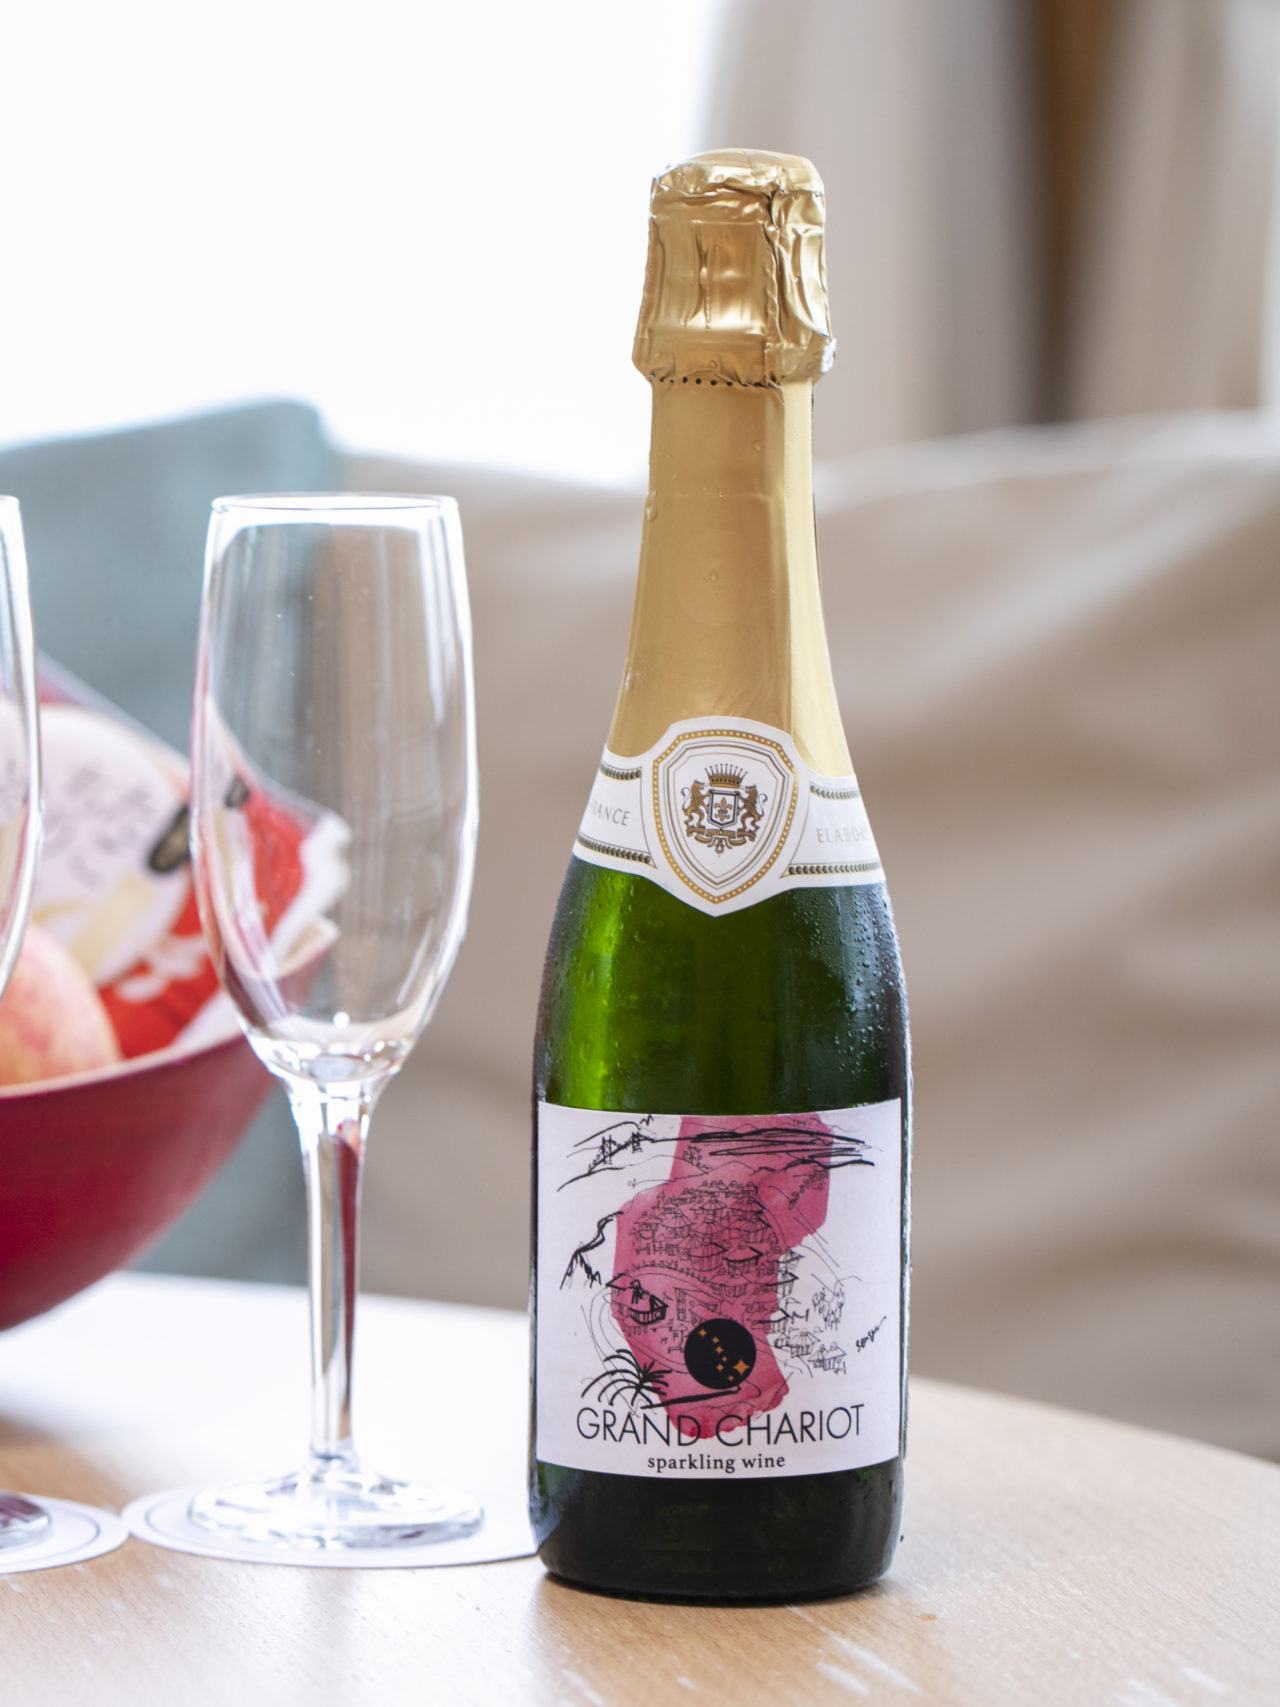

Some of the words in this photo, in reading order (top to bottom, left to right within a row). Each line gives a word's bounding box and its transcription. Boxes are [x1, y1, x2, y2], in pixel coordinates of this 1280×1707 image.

[576, 1406, 702, 1447] GRAND
[715, 1403, 865, 1447] CHARIOT
[647, 1453, 735, 1473] sparkling
[741, 1454, 786, 1469] wine
